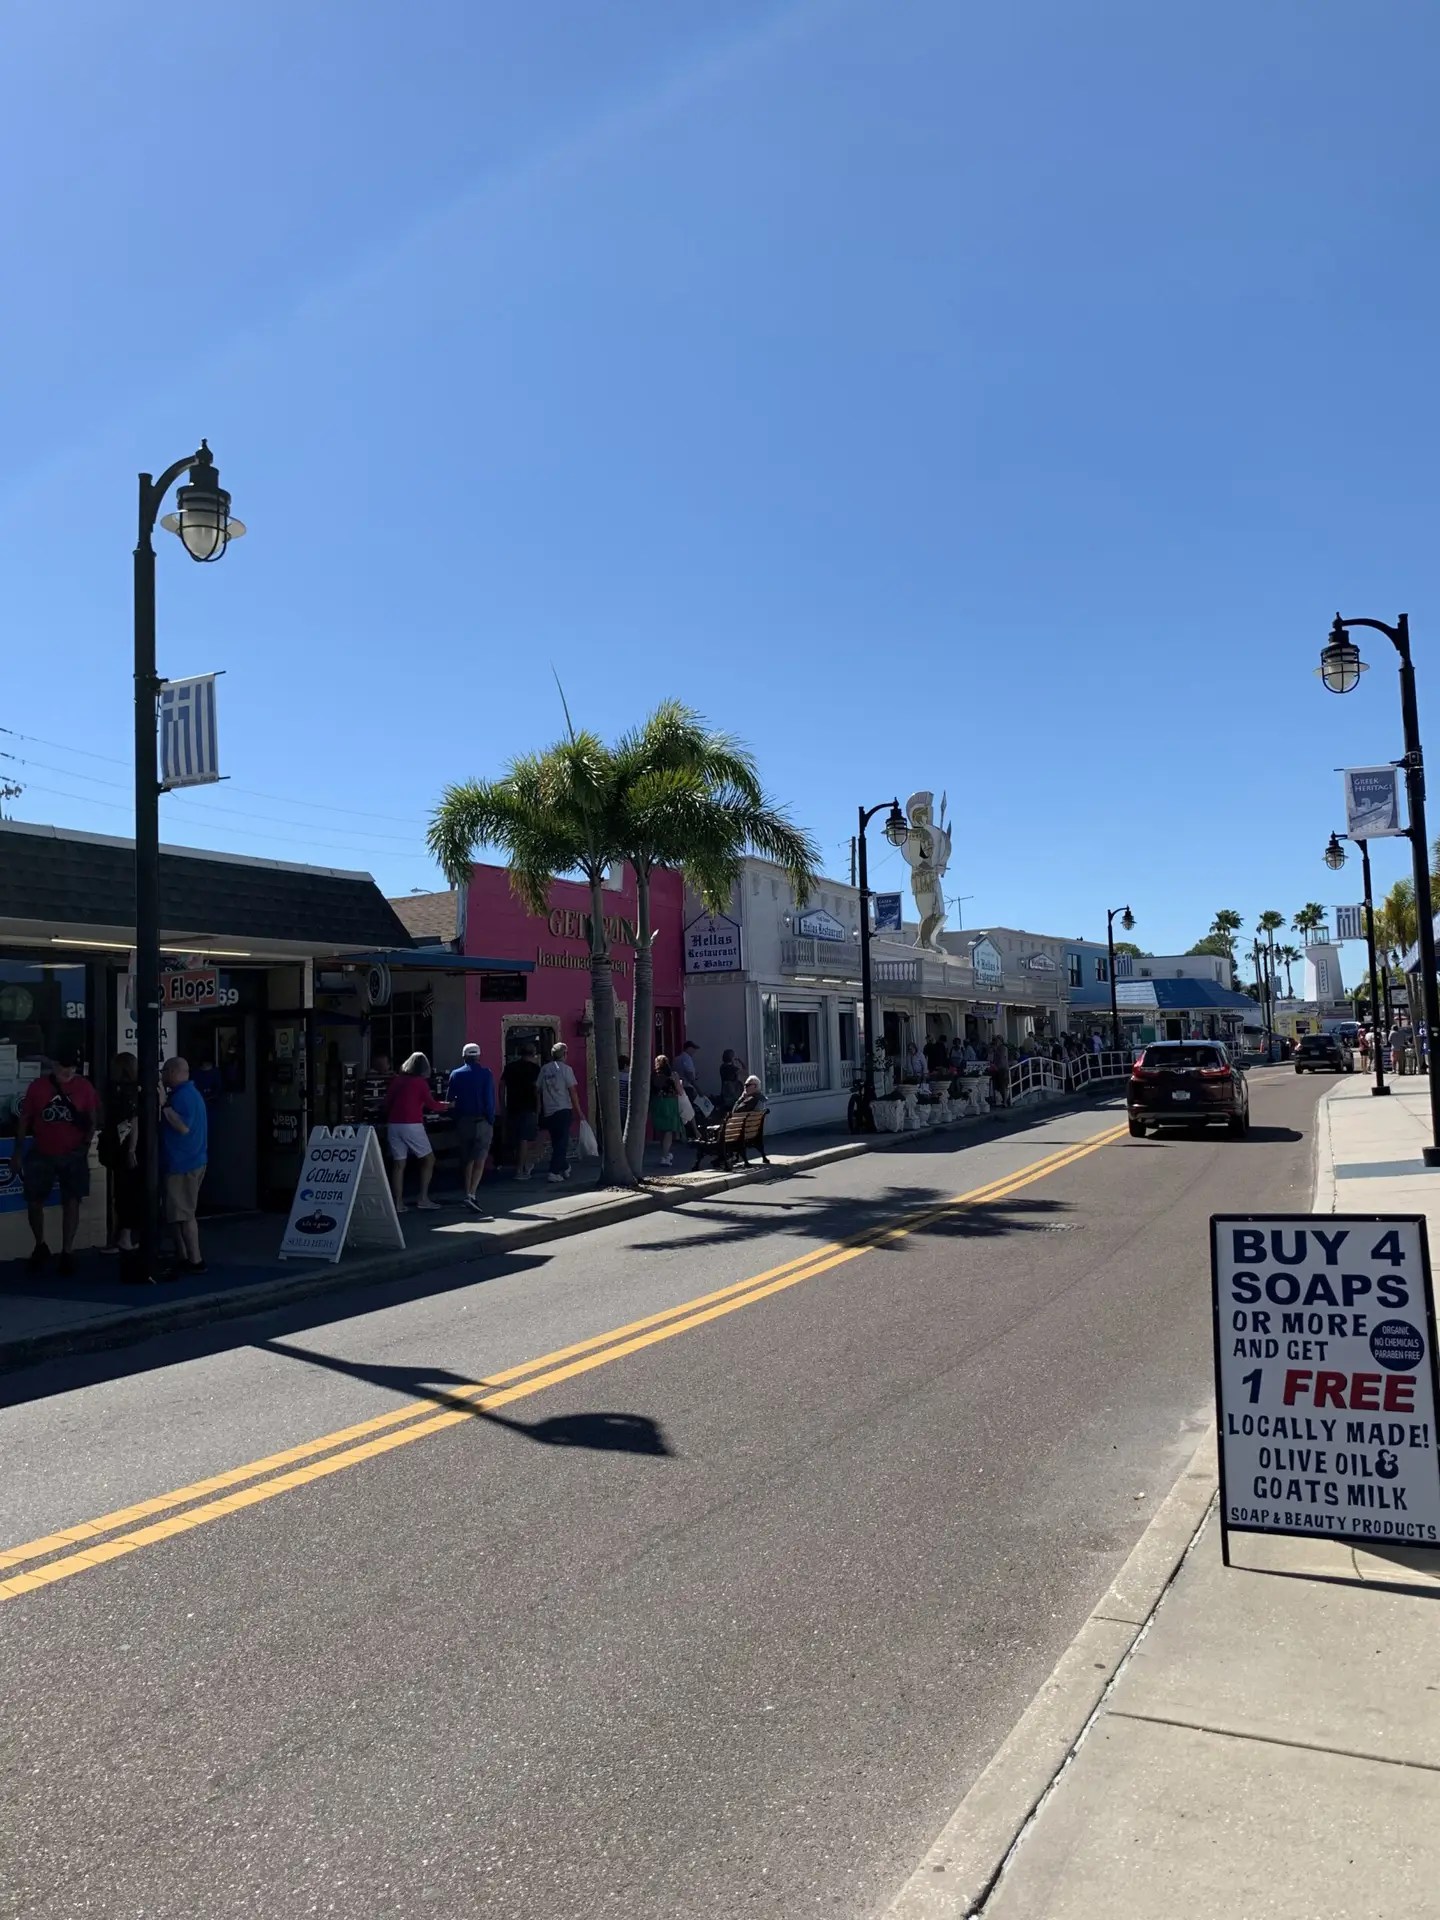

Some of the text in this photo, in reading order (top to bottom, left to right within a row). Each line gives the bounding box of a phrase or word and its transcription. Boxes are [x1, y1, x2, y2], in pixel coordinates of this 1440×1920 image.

[1354, 777, 1379, 786] GREEK
[1354, 784, 1393, 792] HERITAGE
[690, 934, 732, 947] Hellas
[537, 946, 592, 971] handmad
[687, 947, 737, 958] Restaurant
[692, 959, 733, 970] & Bakery
[311, 1149, 357, 1162] OOFOS
[315, 1190, 343, 1201] COSTA
[1233, 1229, 1405, 1267] BUY 4
[1231, 1271, 1409, 1309] SOAPS
[1232, 1310, 1368, 1338] OR MORE
[1382, 1325, 1410, 1335] ORGANIC
[1233, 1338, 1329, 1361] AND GET
[1374, 1337, 1420, 1348] NO CHEMICALS
[1374, 1349, 1421, 1361] PARABEN FREE
[1242, 1368, 1417, 1413] 1 FREE
[1228, 1413, 1430, 1449] LOCALLY MADE!
[1259, 1447, 1328, 1474] OLIVE
[1253, 1475, 1408, 1511] GOATS MILK
[1231, 1506, 1437, 1541] SOAP & BEAUTY PRODUCTS
